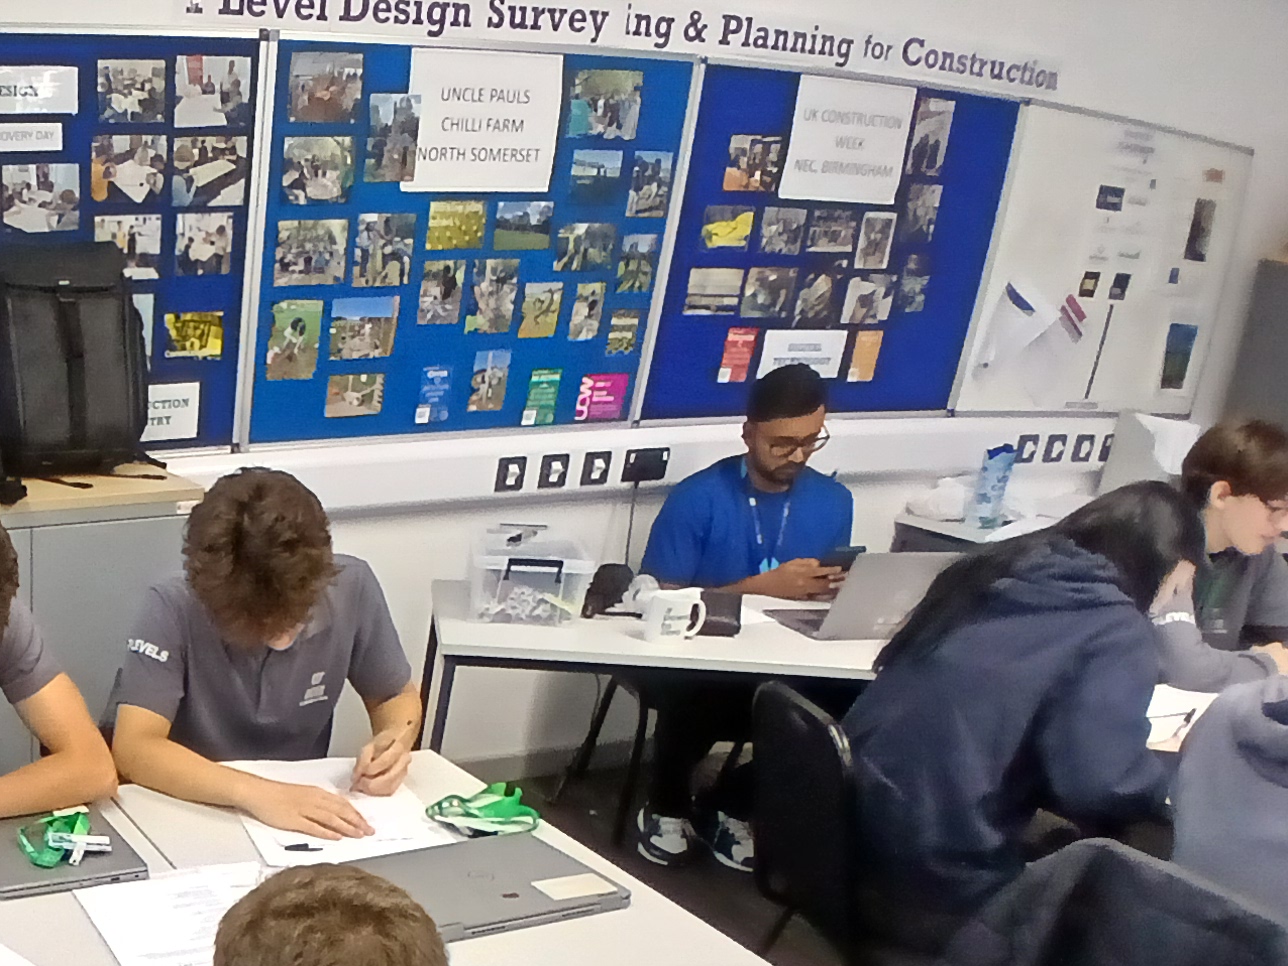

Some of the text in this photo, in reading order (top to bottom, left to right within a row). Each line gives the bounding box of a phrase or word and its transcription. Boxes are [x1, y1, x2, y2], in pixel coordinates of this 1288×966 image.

[338, 0, 471, 37] Design
[487, 0, 610, 43] Survey
[683, 10, 706, 43] &
[718, 14, 854, 67] Planning
[863, 34, 893, 61] for
[902, 37, 1059, 91] Construction
[440, 86, 531, 105] UNCLE PAULS
[440, 116, 525, 133] CHILLI FARM
[802, 108, 903, 129] UK CONSTRUCTION
[35, 130, 55, 141] DAY
[834, 136, 866, 151] WEEK
[416, 146, 541, 163] NORTH SOMERSET
[820, 160, 894, 178] BIRMINGHAM
[148, 399, 189, 409] CTION
